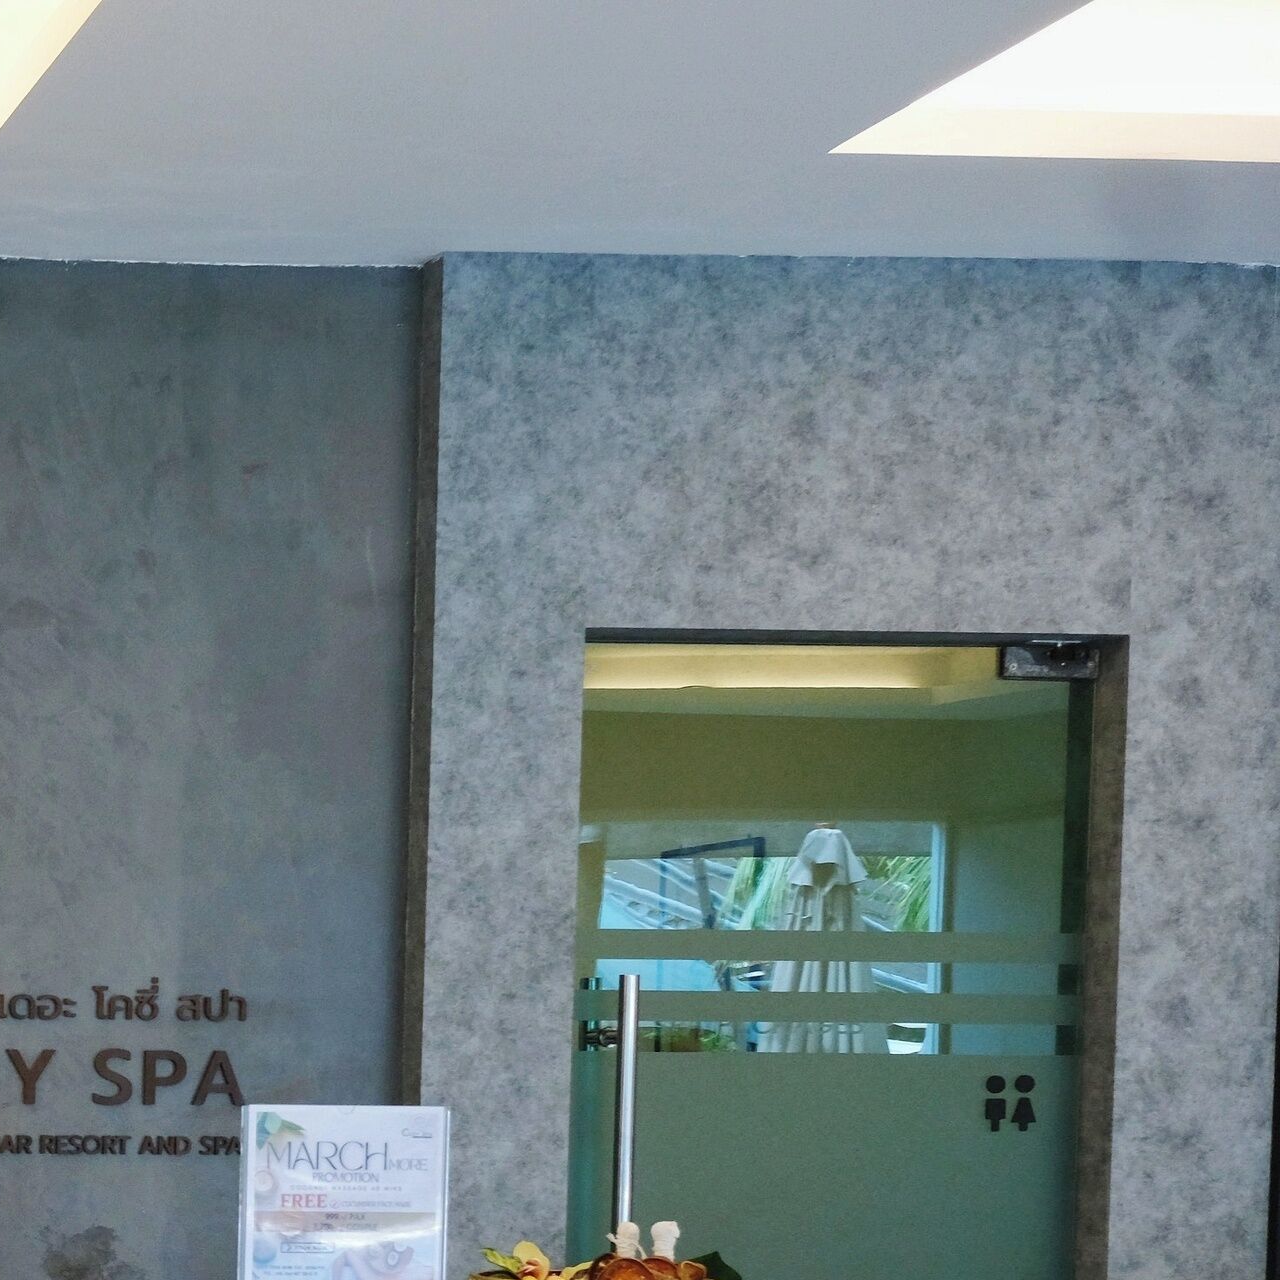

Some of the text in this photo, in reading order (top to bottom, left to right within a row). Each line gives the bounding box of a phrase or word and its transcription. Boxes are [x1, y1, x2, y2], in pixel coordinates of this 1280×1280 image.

[91, 977, 160, 1021] โคซี่
[175, 988, 247, 1022] สปา
[91, 1048, 245, 1107] SPA
[38, 1135, 131, 1155] RESORT
[137, 1136, 190, 1155] AND
[198, 1136, 241, 1156] SPA
[267, 1140, 388, 1171] MARCH
[312, 1171, 380, 1184] PROMOTION
[280, 1193, 328, 1209] FREE
